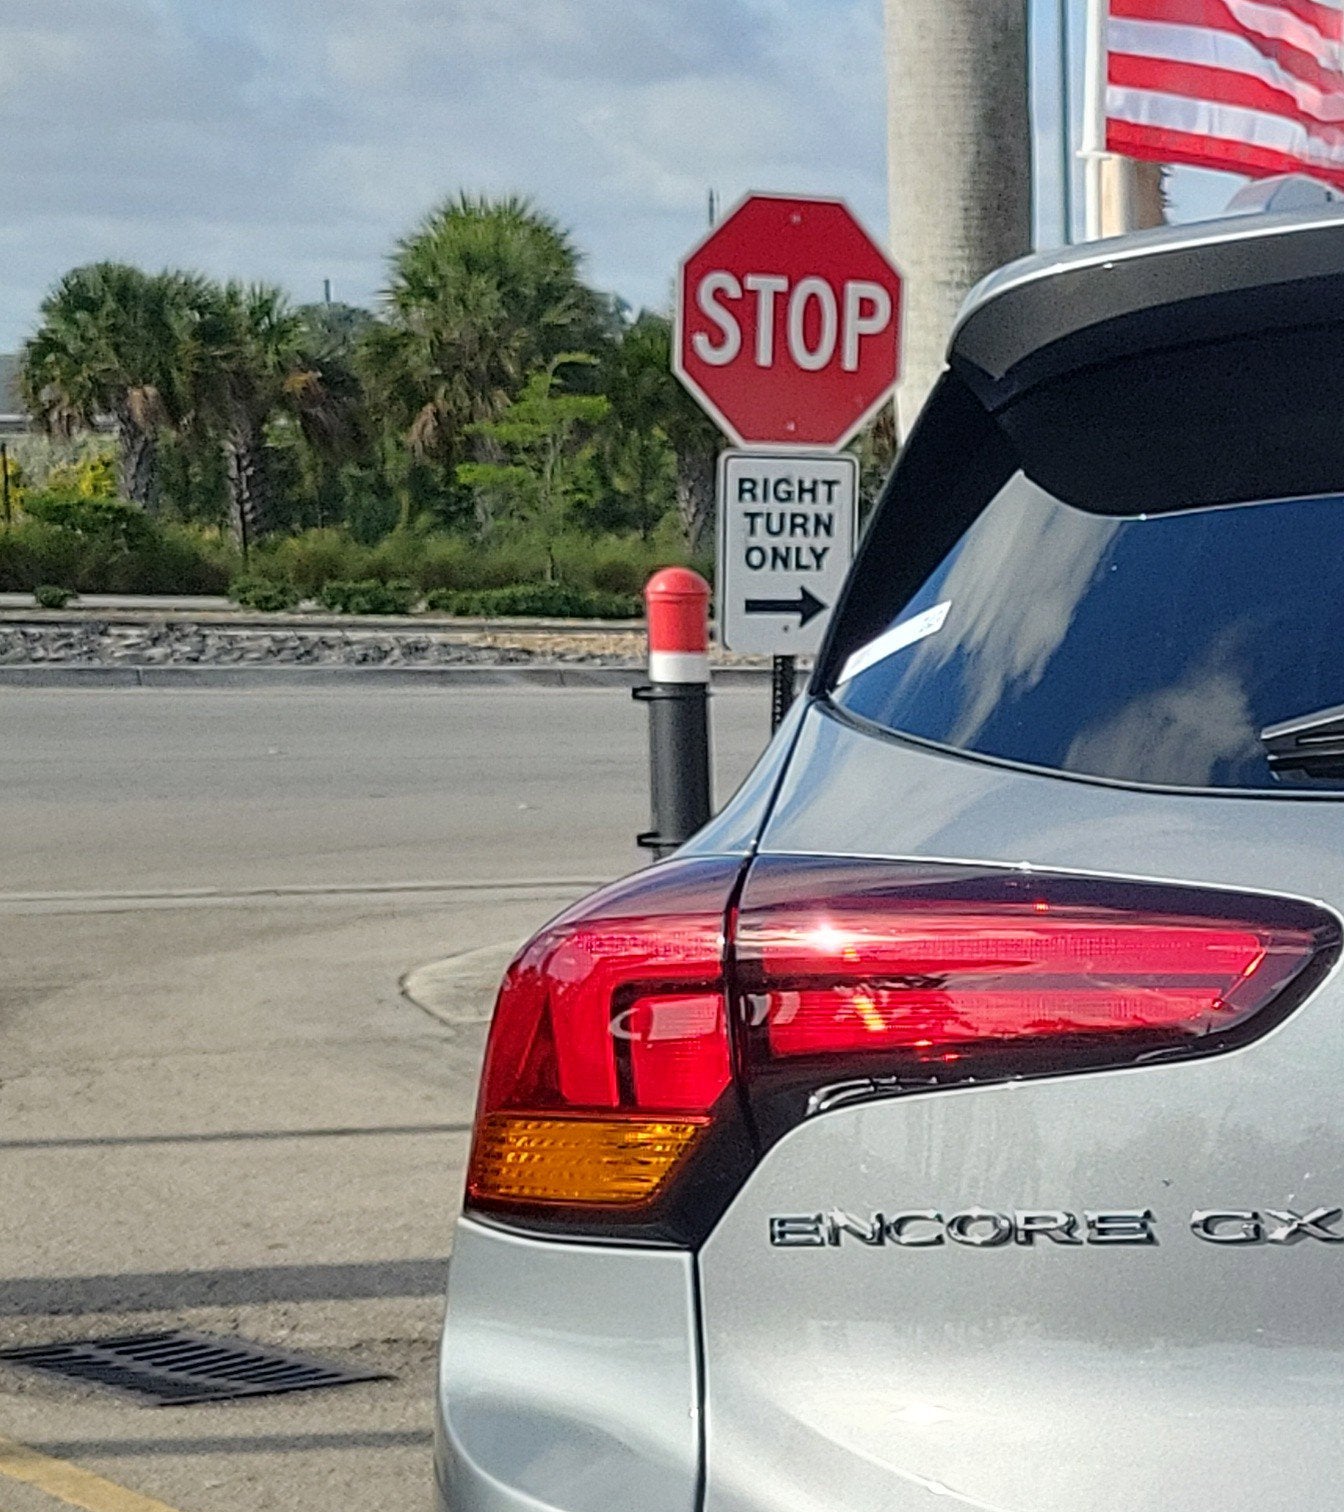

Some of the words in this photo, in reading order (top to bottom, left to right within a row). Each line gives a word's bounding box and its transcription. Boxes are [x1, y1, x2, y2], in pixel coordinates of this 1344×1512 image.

[691, 268, 893, 373] STOP
[737, 476, 841, 505] RIGHT
[743, 512, 834, 538] TURN
[744, 545, 830, 572] ONLY
[769, 1206, 1159, 1248] ENCORE
